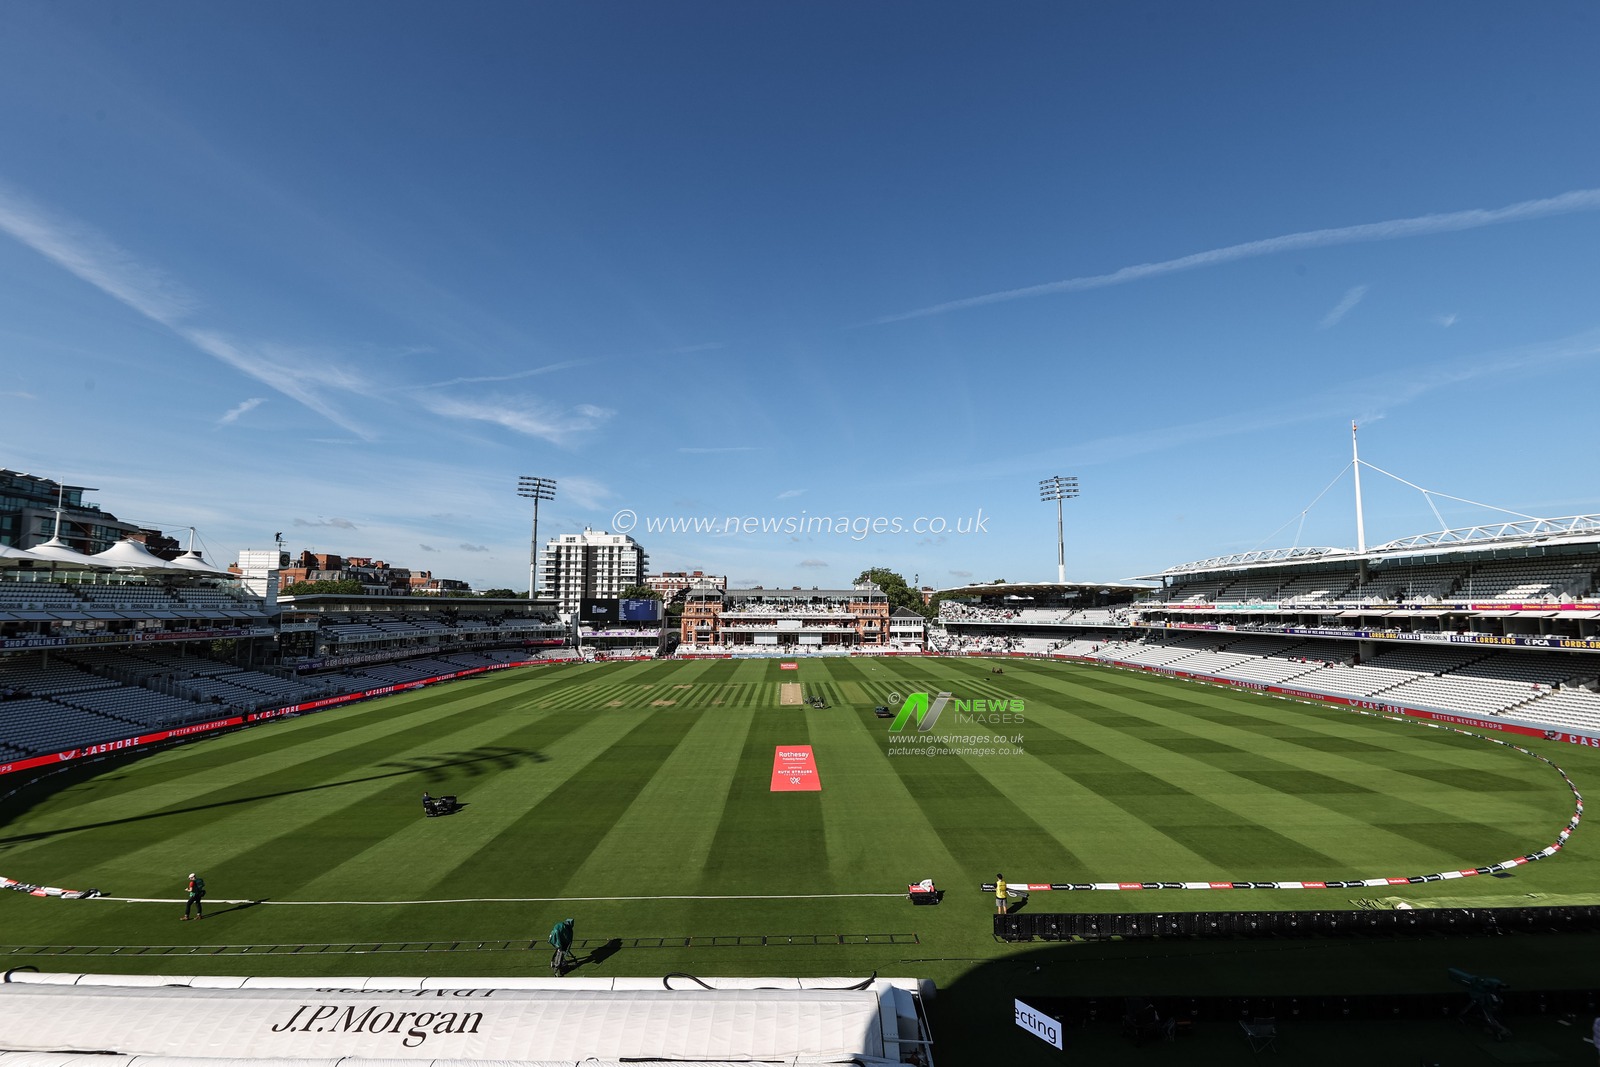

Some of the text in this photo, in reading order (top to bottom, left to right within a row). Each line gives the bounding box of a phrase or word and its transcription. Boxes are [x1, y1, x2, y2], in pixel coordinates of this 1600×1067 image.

[4, 640, 26, 648] SHOP
[1452, 636, 1516, 645] STORE.LORDS.ORG
[373, 686, 394, 695] CASTORE
[169, 720, 227, 737] BETTER NEVER STOPS
[1431, 713, 1503, 730] BETTER NEVER STOPS
[1569, 734, 1600, 748] CAS
[271, 1004, 484, 1048] J.P.Morgan
